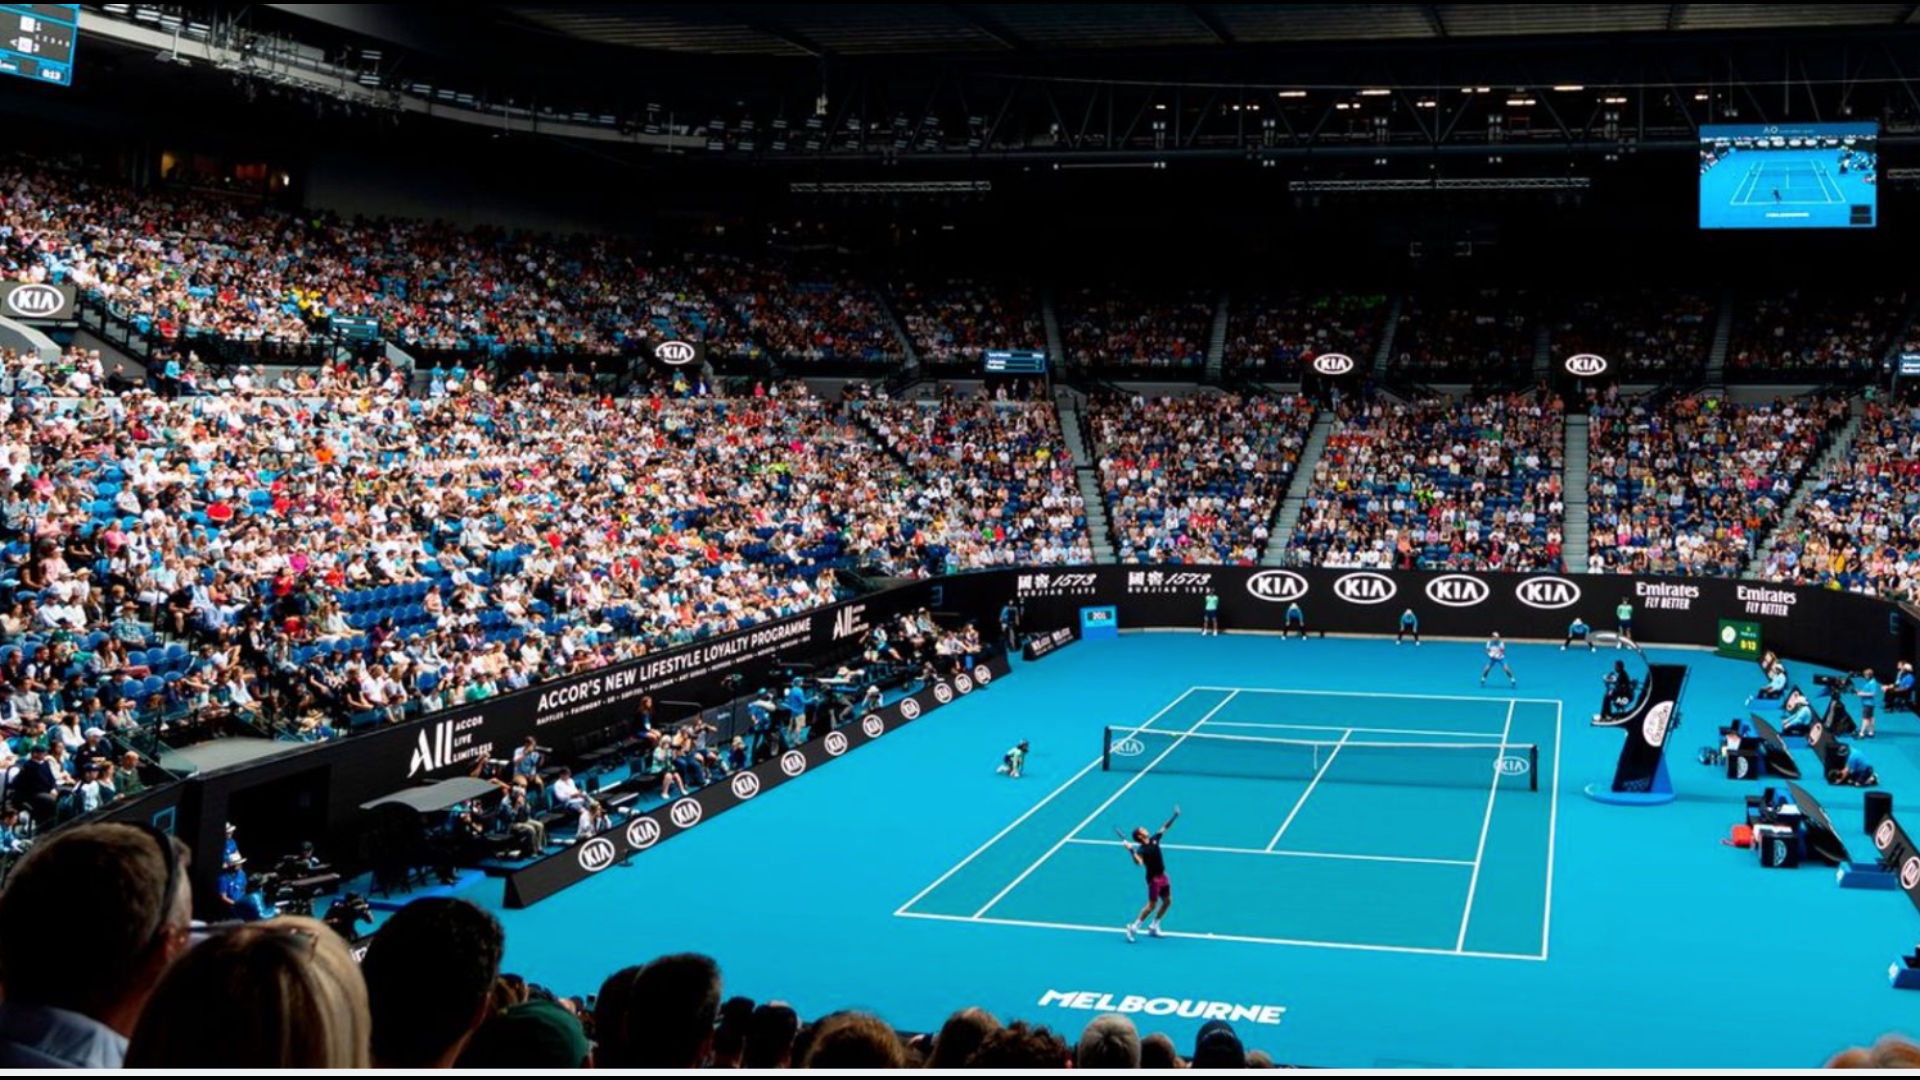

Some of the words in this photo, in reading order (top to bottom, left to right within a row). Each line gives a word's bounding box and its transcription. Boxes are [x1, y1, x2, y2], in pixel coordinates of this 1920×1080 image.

[1051, 573, 1097, 587] 1573
[1165, 573, 1212, 586] 1573
[1636, 582, 1699, 598] Emirates
[1736, 585, 1797, 605] Emirates
[537, 679, 601, 712] ACCOR'S
[605, 668, 637, 692] NEW
[640, 649, 701, 681] LIFESTYLE
[704, 635, 749, 662] LOYALTY
[751, 618, 812, 648] PROGRAMME
[455, 715, 484, 732] ACCOR
[454, 733, 473, 748] LIVE
[1037, 989, 1286, 1025] MELBOURNE
